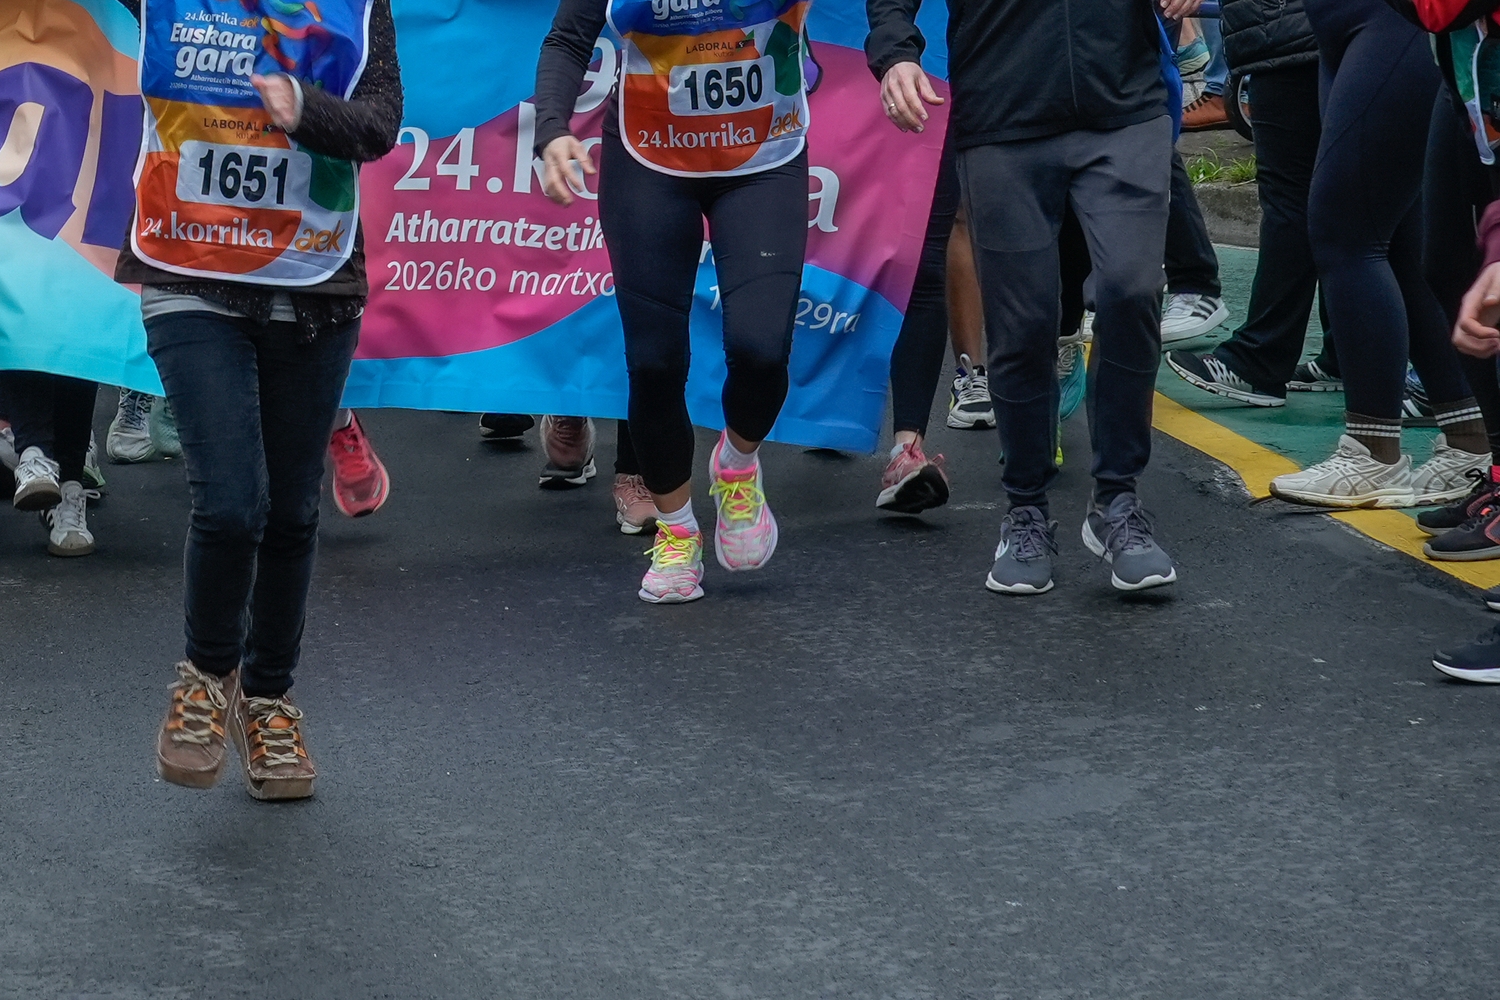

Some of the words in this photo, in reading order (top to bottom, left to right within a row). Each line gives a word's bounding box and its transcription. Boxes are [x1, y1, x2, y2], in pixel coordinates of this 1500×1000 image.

[185, 11, 237, 26] 24.korrika
[170, 23, 257, 50] Euskara
[686, 41, 733, 54] LABORAL
[175, 45, 256, 78] gara
[684, 63, 763, 111] 1650
[203, 117, 260, 131] LABORAL
[637, 122, 757, 149] 24.korrika
[770, 102, 803, 136] aek
[199, 148, 289, 205] 1651
[140, 211, 275, 249] 24.korrika
[294, 219, 346, 252] aek
[384, 258, 497, 292] 2026ko
